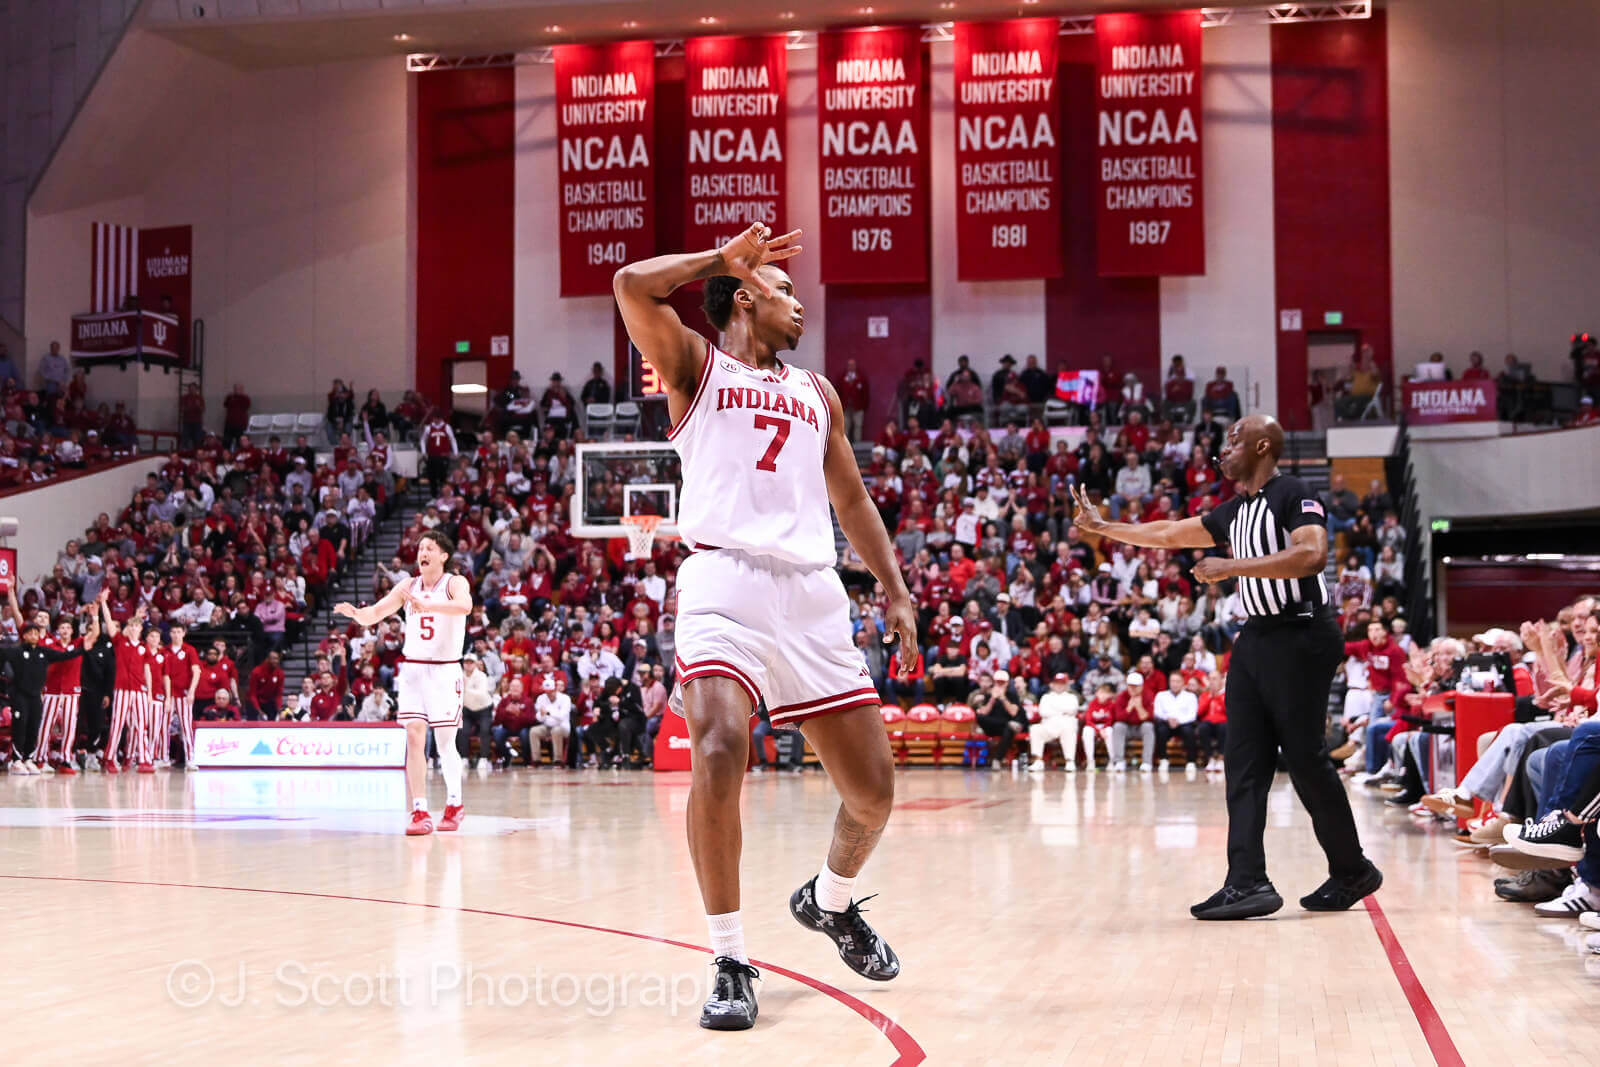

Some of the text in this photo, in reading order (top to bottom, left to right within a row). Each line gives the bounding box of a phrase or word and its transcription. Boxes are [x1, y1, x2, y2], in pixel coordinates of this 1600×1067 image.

[972, 50, 1043, 77] INDIANA
[1112, 43, 1185, 70] INDIANA
[702, 65, 769, 91] INDIANA
[836, 58, 906, 84] INDIANA
[571, 72, 637, 98] INDIANA
[825, 85, 916, 111] UNIVERSITY
[961, 78, 1053, 105] UNIVERSITY
[1101, 72, 1195, 99] UNIVERSITY
[562, 99, 647, 126] UNIVERSITY
[691, 93, 779, 118] UNIVERSITY
[823, 119, 918, 157] NCAA
[959, 113, 1055, 151] NCAA
[1099, 108, 1198, 147] NCAA
[562, 134, 649, 172] NCAA
[689, 128, 782, 164] NCAA
[824, 167, 915, 191] BASKETBALL
[962, 160, 1053, 187] BASKETBALL
[1101, 155, 1196, 182] BASKETBALL
[564, 180, 647, 206] BASKETBALL
[690, 173, 779, 198] BASKETBALL
[1106, 184, 1193, 211] CHAMPIONS
[695, 201, 777, 226] CHAMPIONS
[828, 194, 912, 218] CHAMPIONS
[966, 187, 1050, 215] CHAMPIONS
[567, 206, 644, 233] CHAMPIONS
[852, 227, 892, 252] 1976
[991, 224, 1027, 249] 1981
[1129, 220, 1171, 246] 1987
[588, 241, 627, 266] 1940
[78, 319, 129, 340] INDIANA
[716, 387, 819, 432] INDIANA
[1411, 387, 1487, 409] INDIANA
[753, 414, 791, 472] 7
[420, 616, 435, 641] 5
[276, 736, 392, 756] Coors LIGHT
